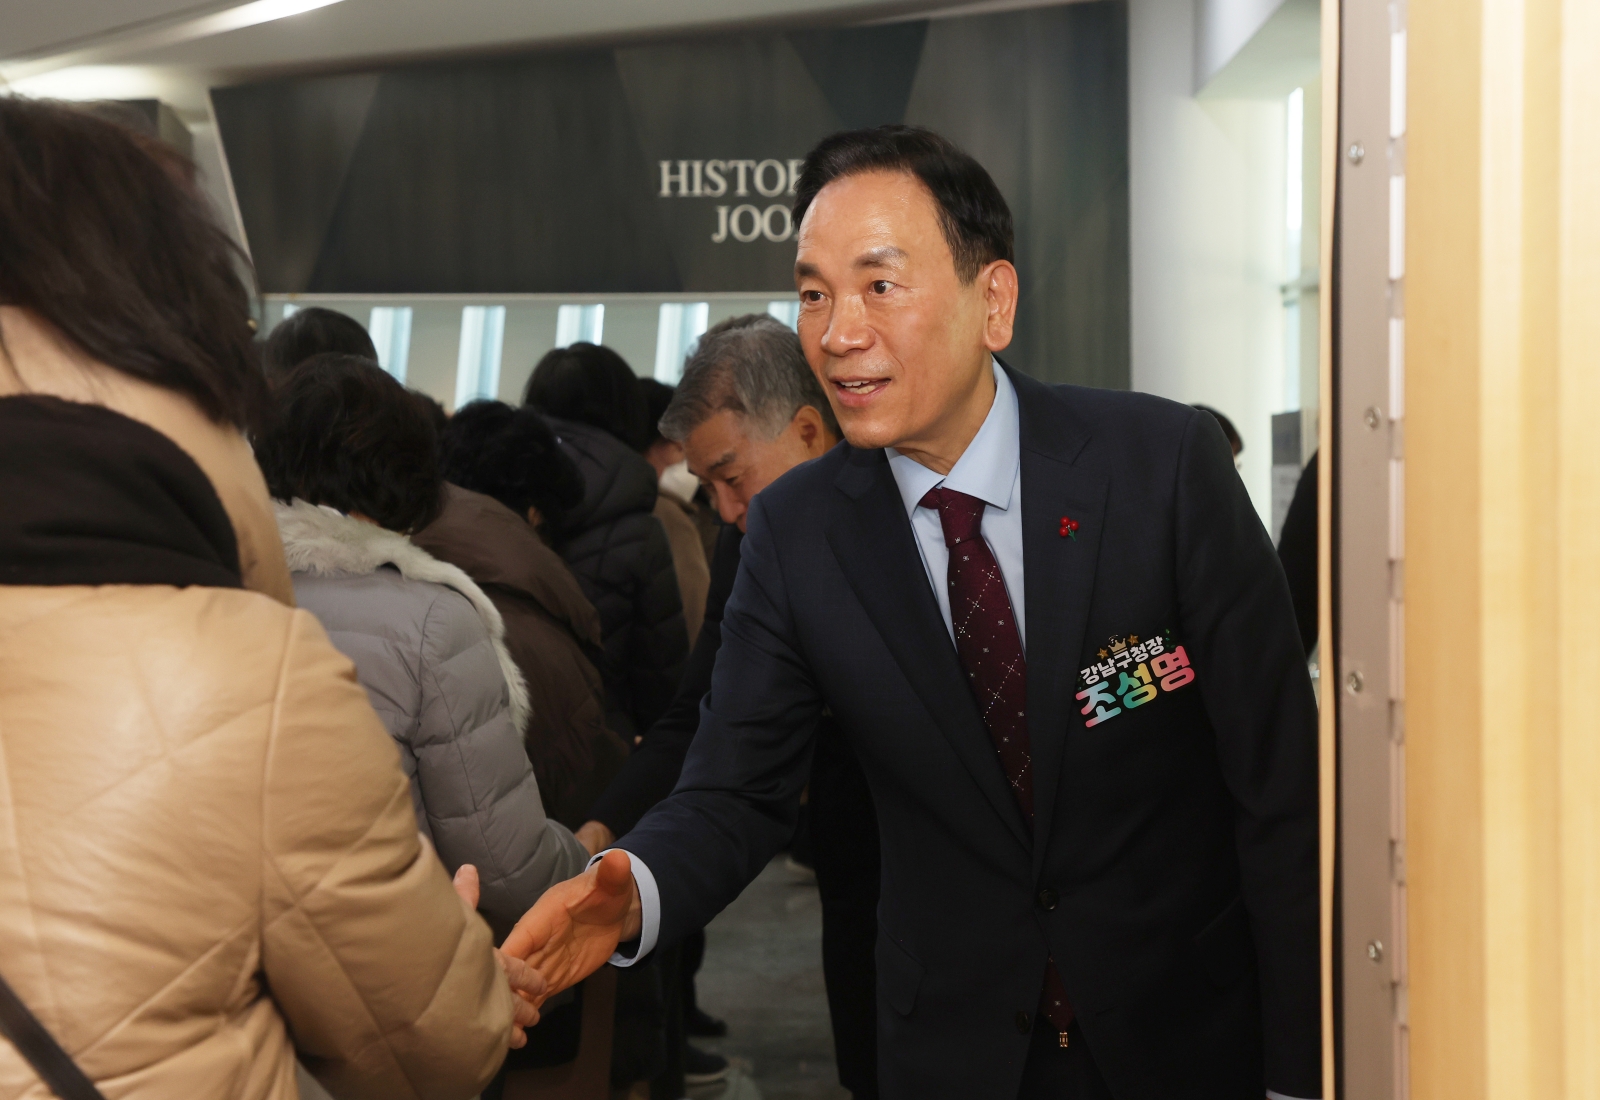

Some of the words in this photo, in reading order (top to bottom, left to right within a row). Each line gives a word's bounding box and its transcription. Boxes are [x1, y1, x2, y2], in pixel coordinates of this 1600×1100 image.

[711, 203, 799, 244] JOO
[1080, 635, 1165, 685] 강남구청장
[1075, 645, 1195, 728] 조성명
